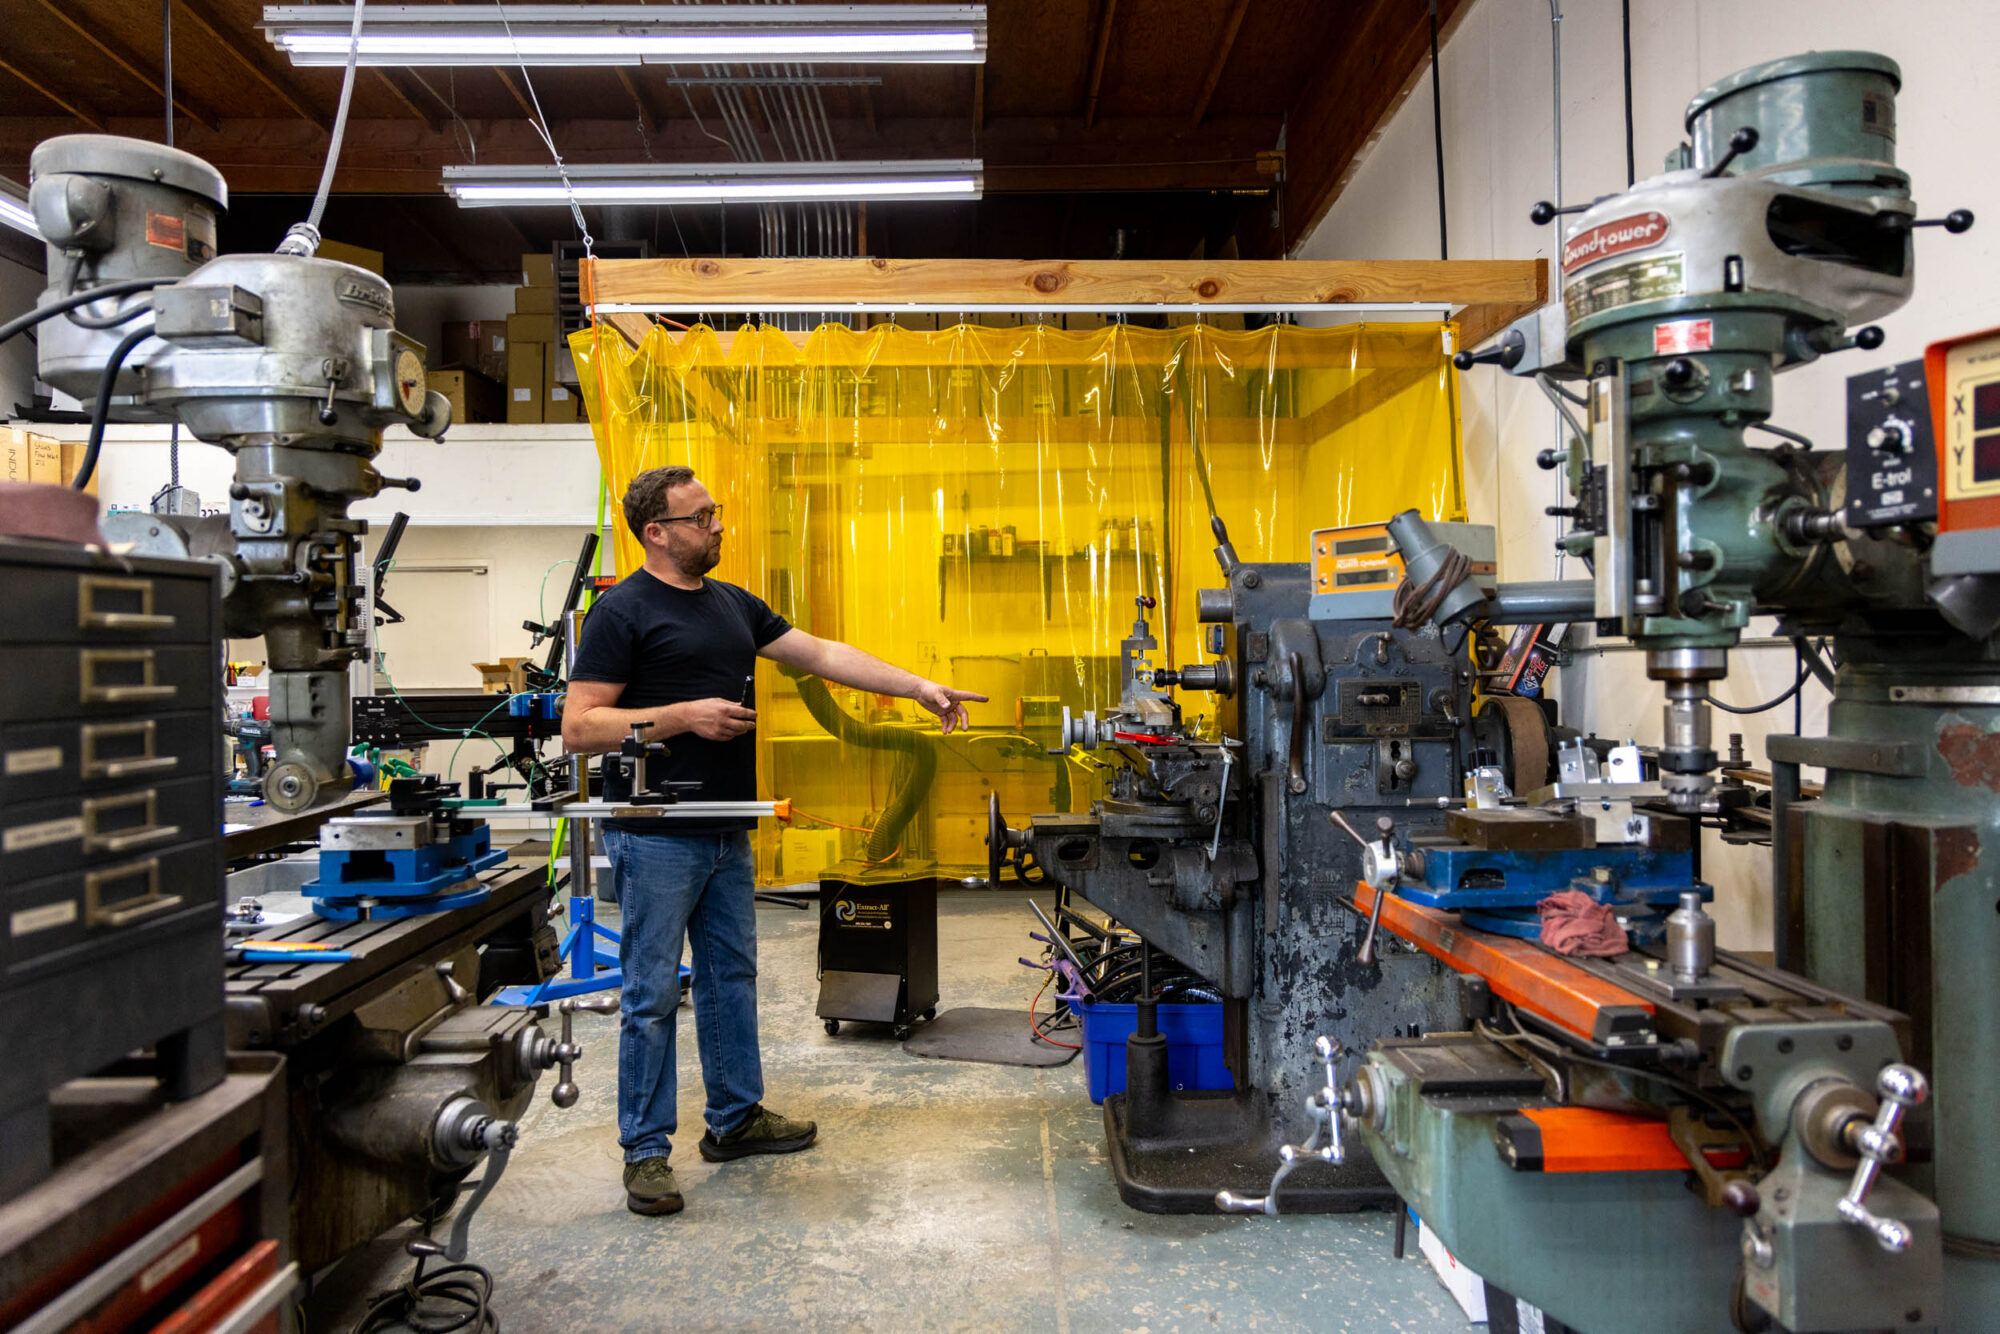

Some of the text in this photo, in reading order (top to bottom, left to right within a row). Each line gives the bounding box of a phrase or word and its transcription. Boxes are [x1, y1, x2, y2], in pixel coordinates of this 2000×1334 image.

[1954, 394, 1965, 416] X
[1954, 446, 1965, 466] Y
[1872, 467, 1912, 490] E-trol
[856, 903, 888, 911] Extract-All
